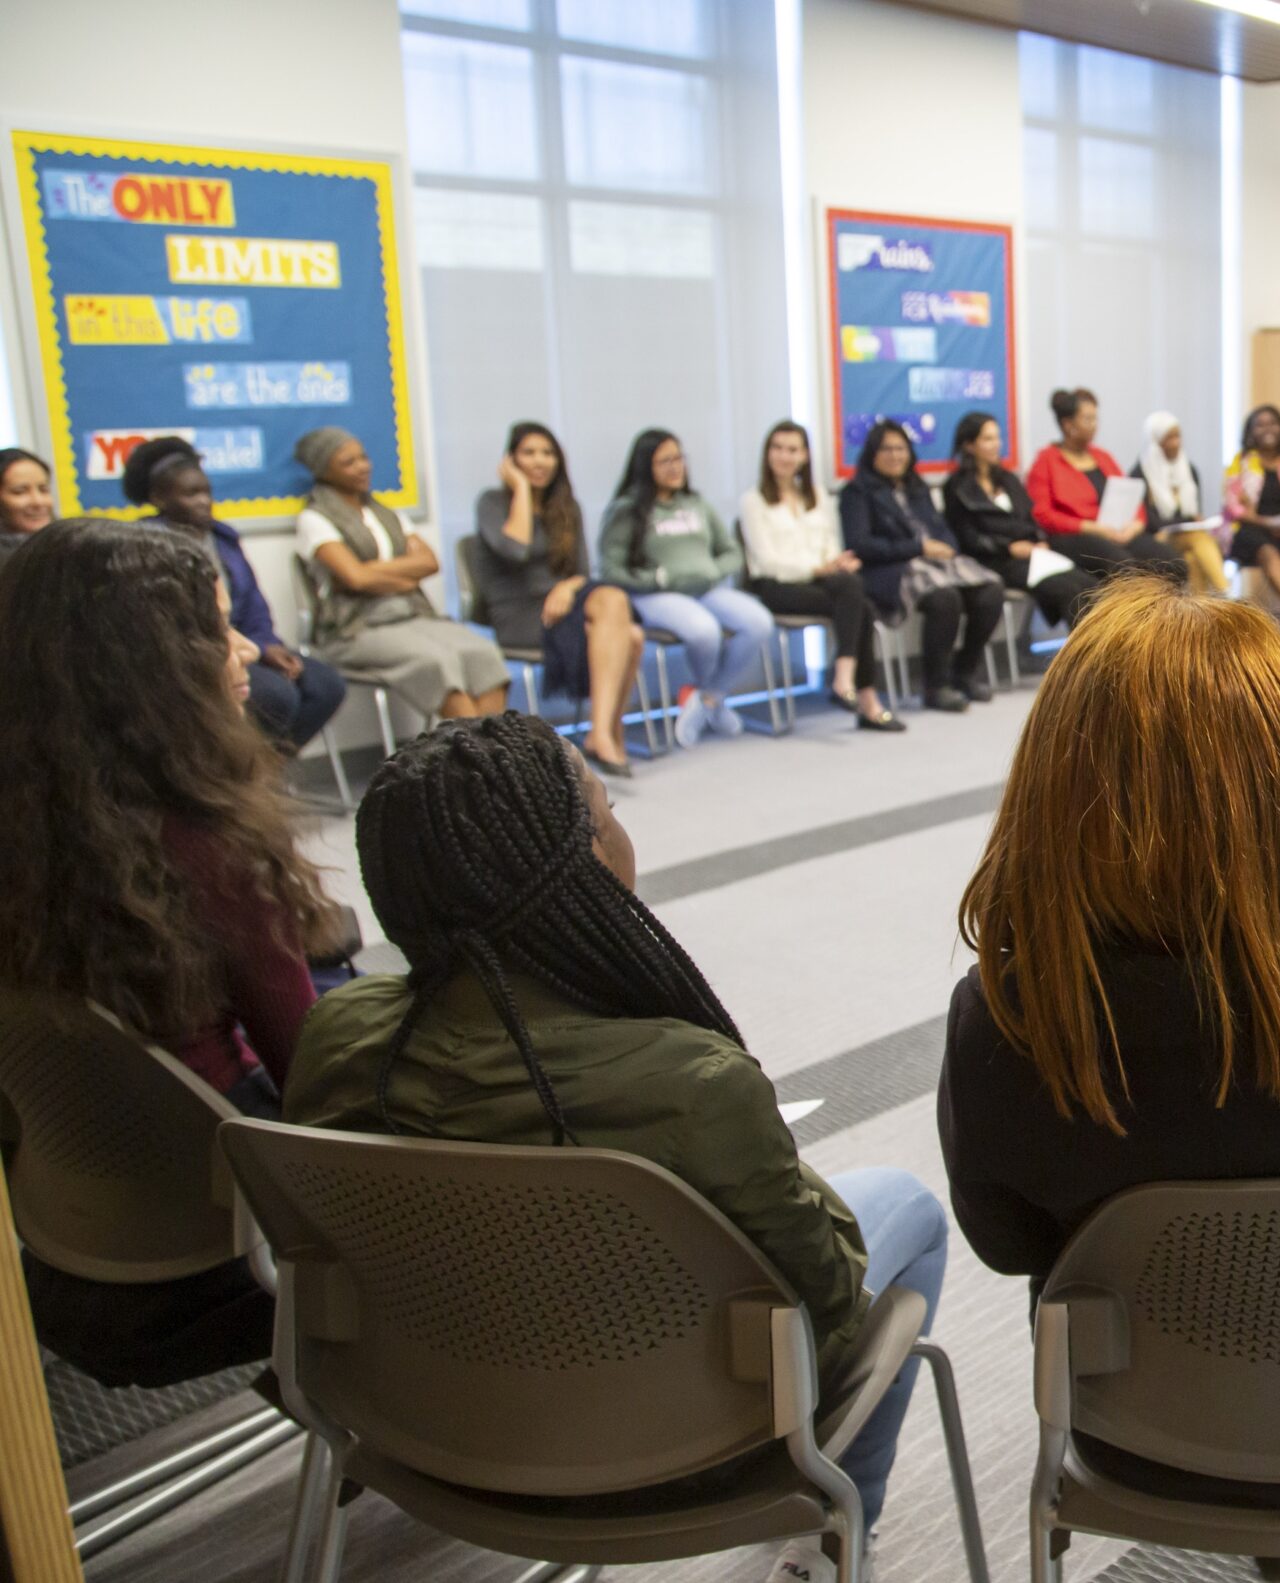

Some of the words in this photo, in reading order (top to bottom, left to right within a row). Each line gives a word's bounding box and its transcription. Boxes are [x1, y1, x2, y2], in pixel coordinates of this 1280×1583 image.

[63, 176, 110, 217] The
[112, 178, 224, 224] ONLY
[172, 237, 338, 285] LIMITS
[169, 296, 242, 343] life
[193, 380, 237, 405] are
[245, 363, 292, 405] the
